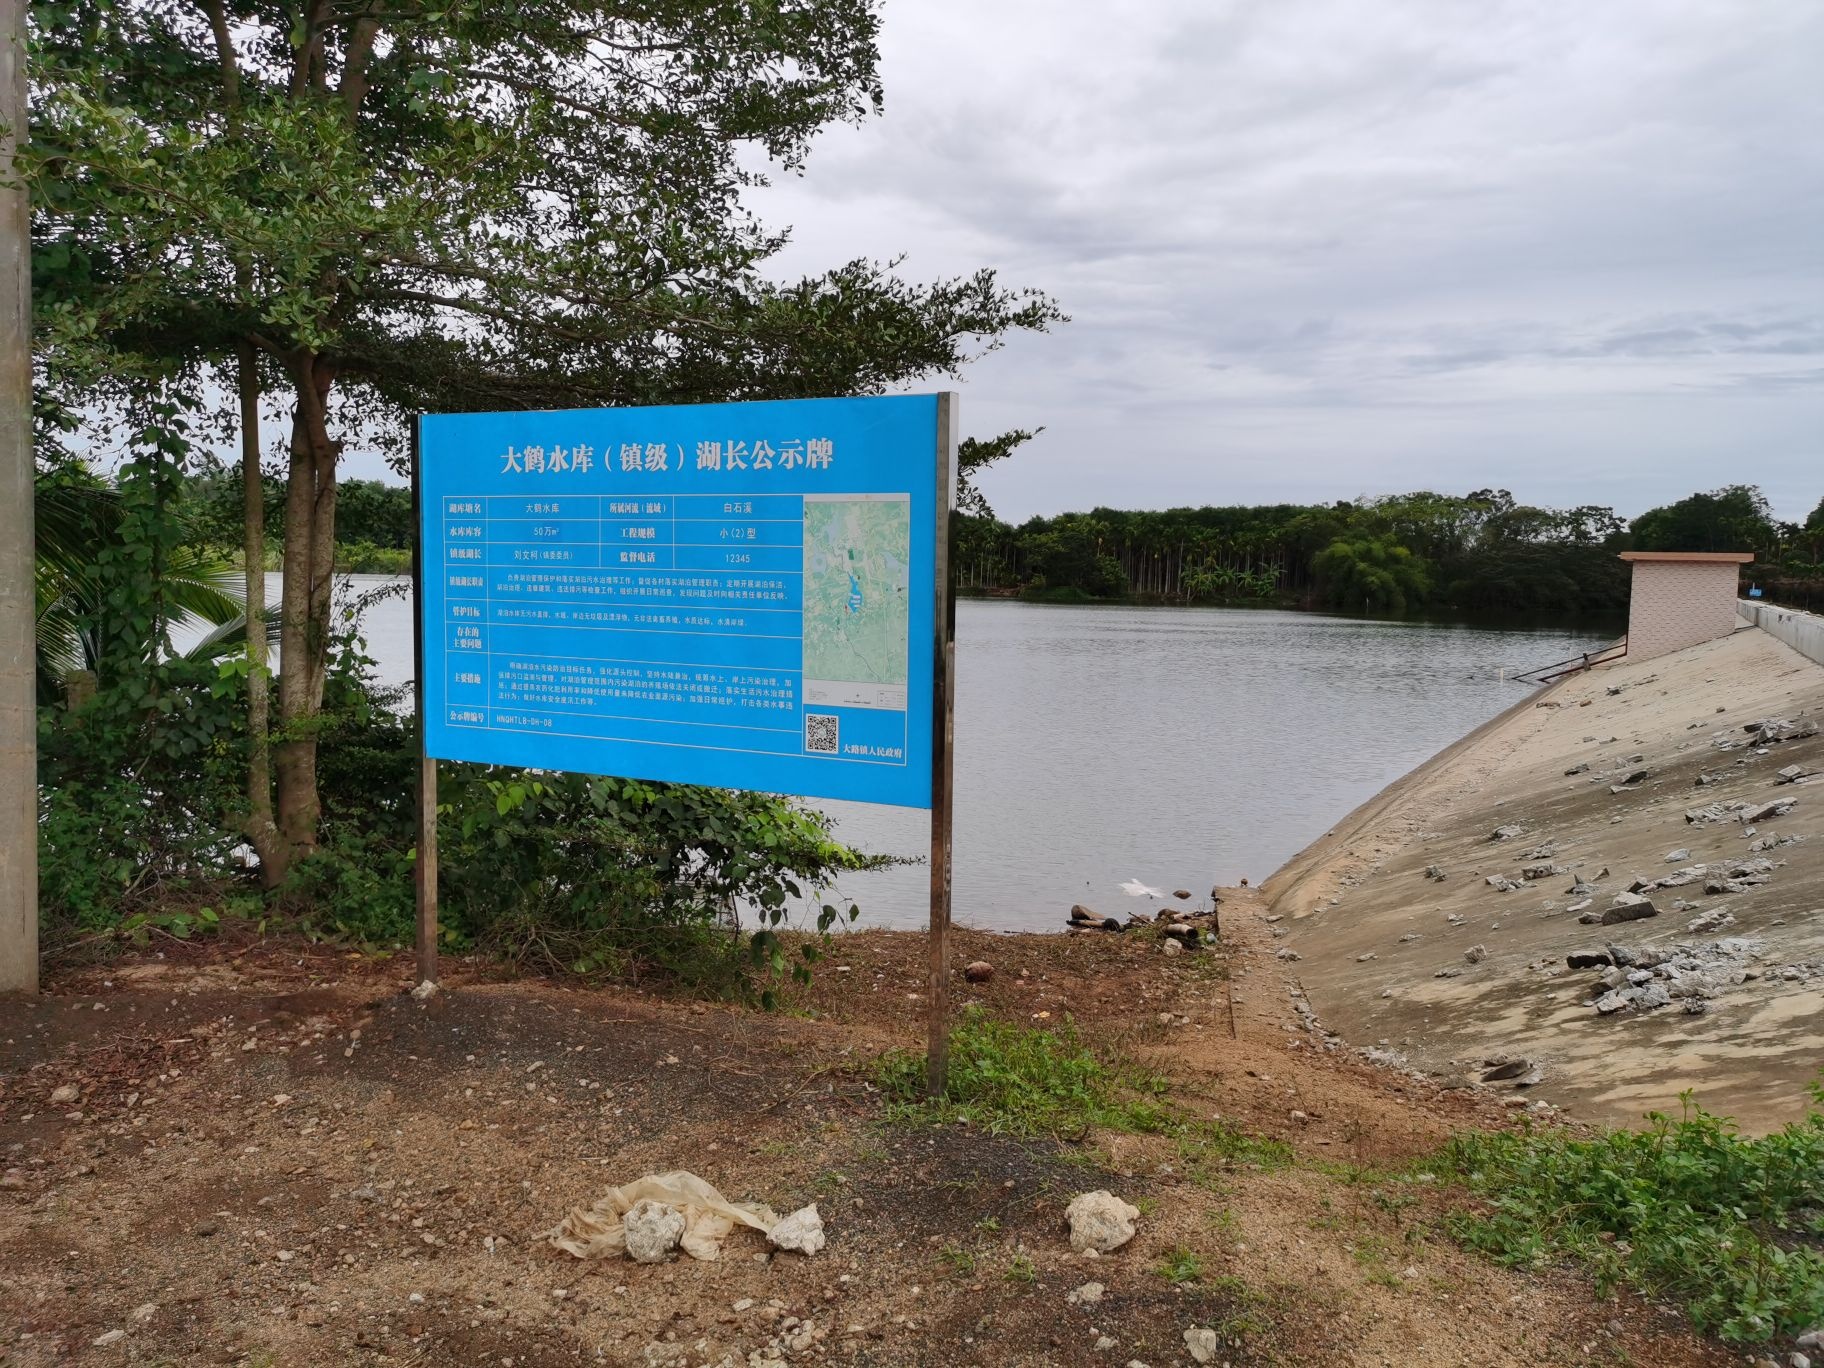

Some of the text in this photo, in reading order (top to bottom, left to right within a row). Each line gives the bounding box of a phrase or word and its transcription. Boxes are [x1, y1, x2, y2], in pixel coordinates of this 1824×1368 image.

[500, 437, 834, 474] 大鹤水库（镇级）湖长公示牌
[525, 503, 560, 513] 大鹤水库
[724, 502, 753, 514] 白石溪
[450, 526, 481, 537] 水库库容
[621, 527, 656, 539] 工程规模
[450, 548, 481, 559] 镇级湖长
[620, 551, 656, 563] 监督电话
[725, 553, 750, 563] 12345
[453, 606, 481, 617] 管护目标
[457, 626, 479, 638] 存在的
[454, 638, 482, 649] 主要问题
[455, 672, 481, 684] 主要措施
[450, 711, 484, 723] 公示牌编号
[843, 744, 902, 758] 大路镇人民政府
